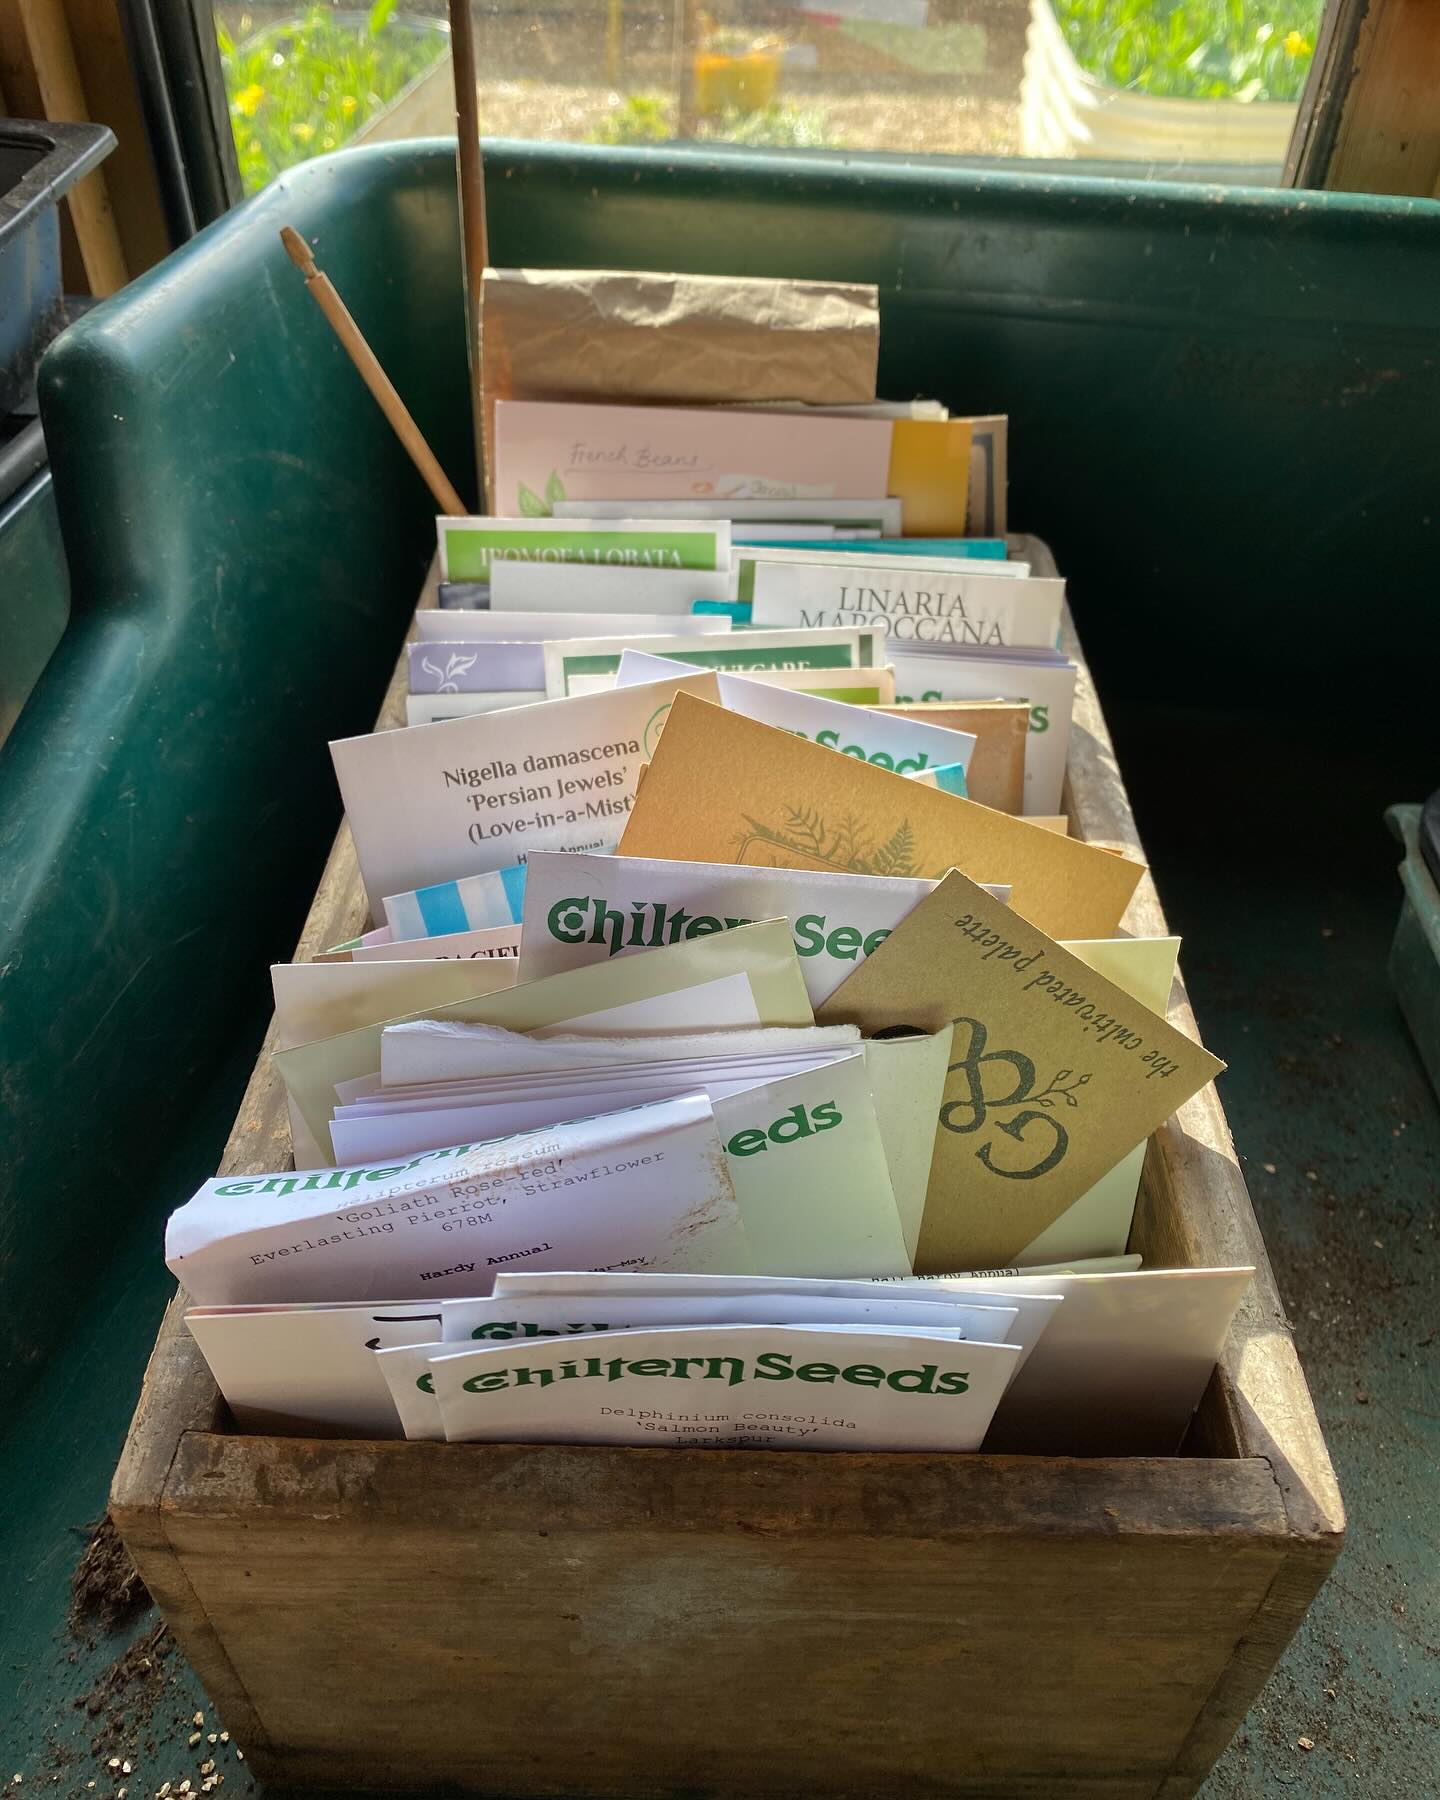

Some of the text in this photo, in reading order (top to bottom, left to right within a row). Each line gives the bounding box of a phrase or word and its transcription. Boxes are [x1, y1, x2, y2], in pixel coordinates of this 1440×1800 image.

[568, 440, 627, 465] French
[839, 586, 967, 618] LINARIA
[441, 740, 641, 789] Nigella damascena
[547, 896, 762, 957] Chilte
[954, 913, 1180, 1080] the cultivated palette
[723, 1100, 843, 1157] eds
[250, 1151, 666, 1267] Everlasting Pierrot, Strawflower
[441, 1212, 494, 1233] 678M
[419, 1242, 553, 1281] Hardy Annual
[462, 1356, 745, 1394] Chiltern
[753, 1352, 971, 1396] Seeds
[600, 1406, 857, 1430] Delphinium consolida
